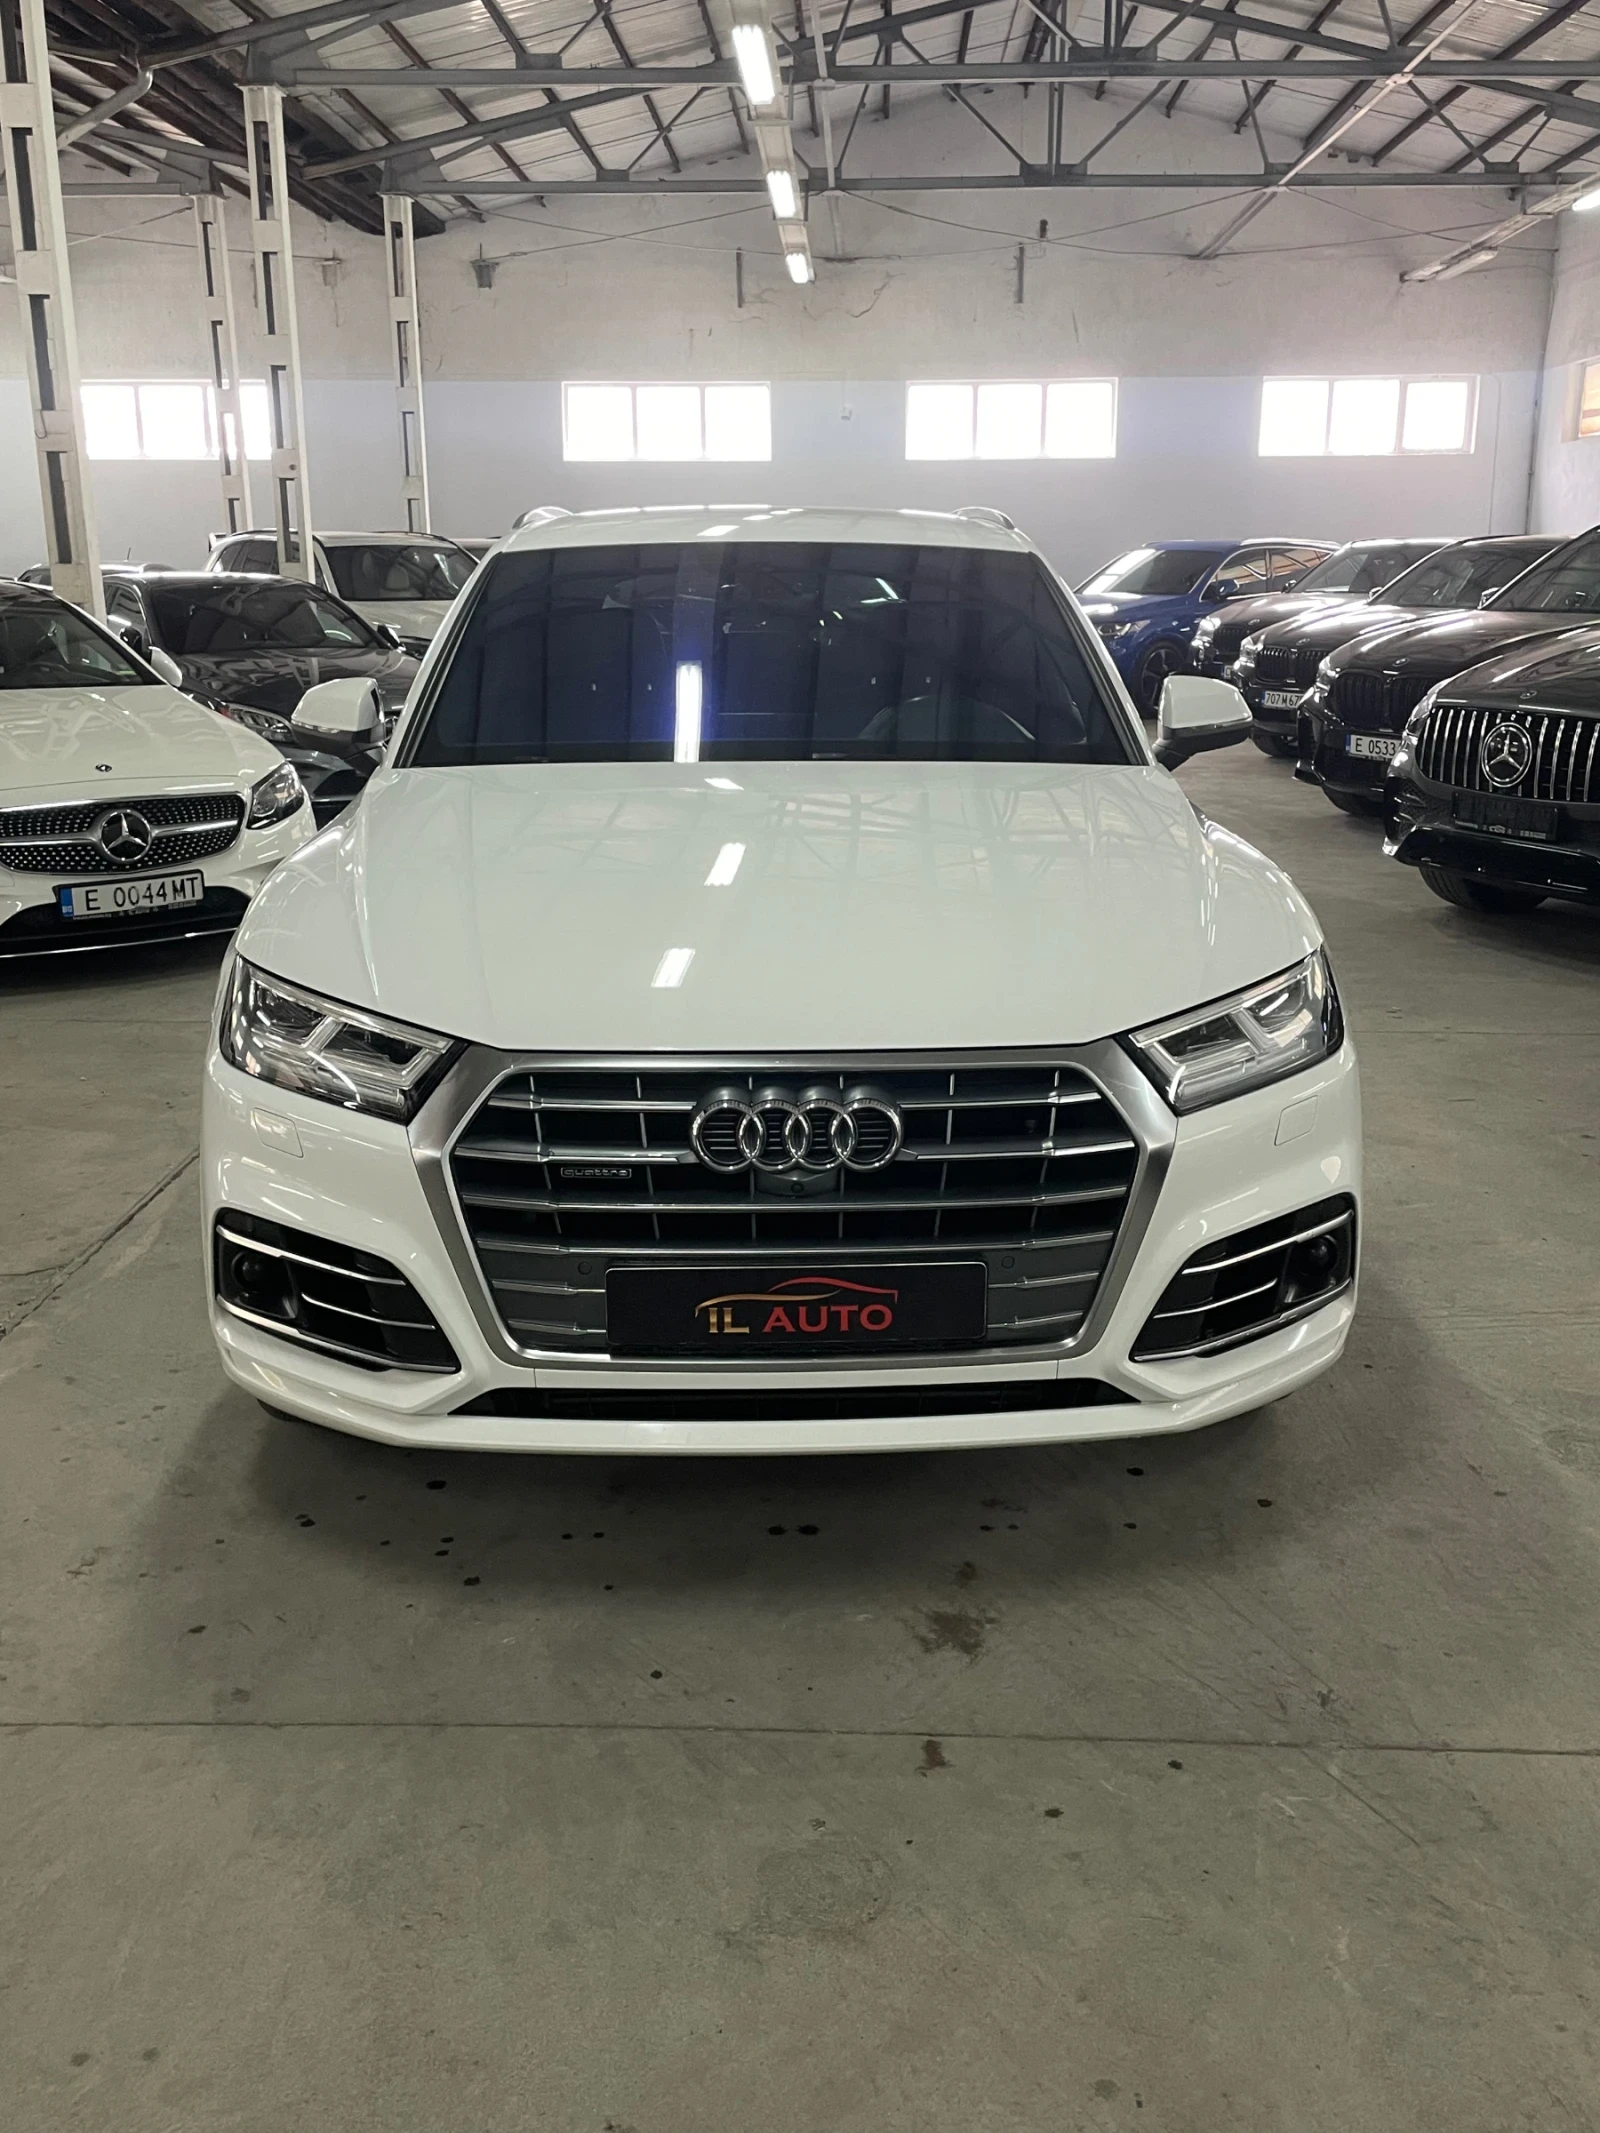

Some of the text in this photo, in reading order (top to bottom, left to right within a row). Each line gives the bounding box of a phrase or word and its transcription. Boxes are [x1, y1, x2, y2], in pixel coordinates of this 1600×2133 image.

[1355, 738, 1396, 757] E 0533
[85, 877, 199, 911] E 0044MT
[563, 1168, 630, 1178] quattro
[708, 1304, 893, 1333] IL AUTO
